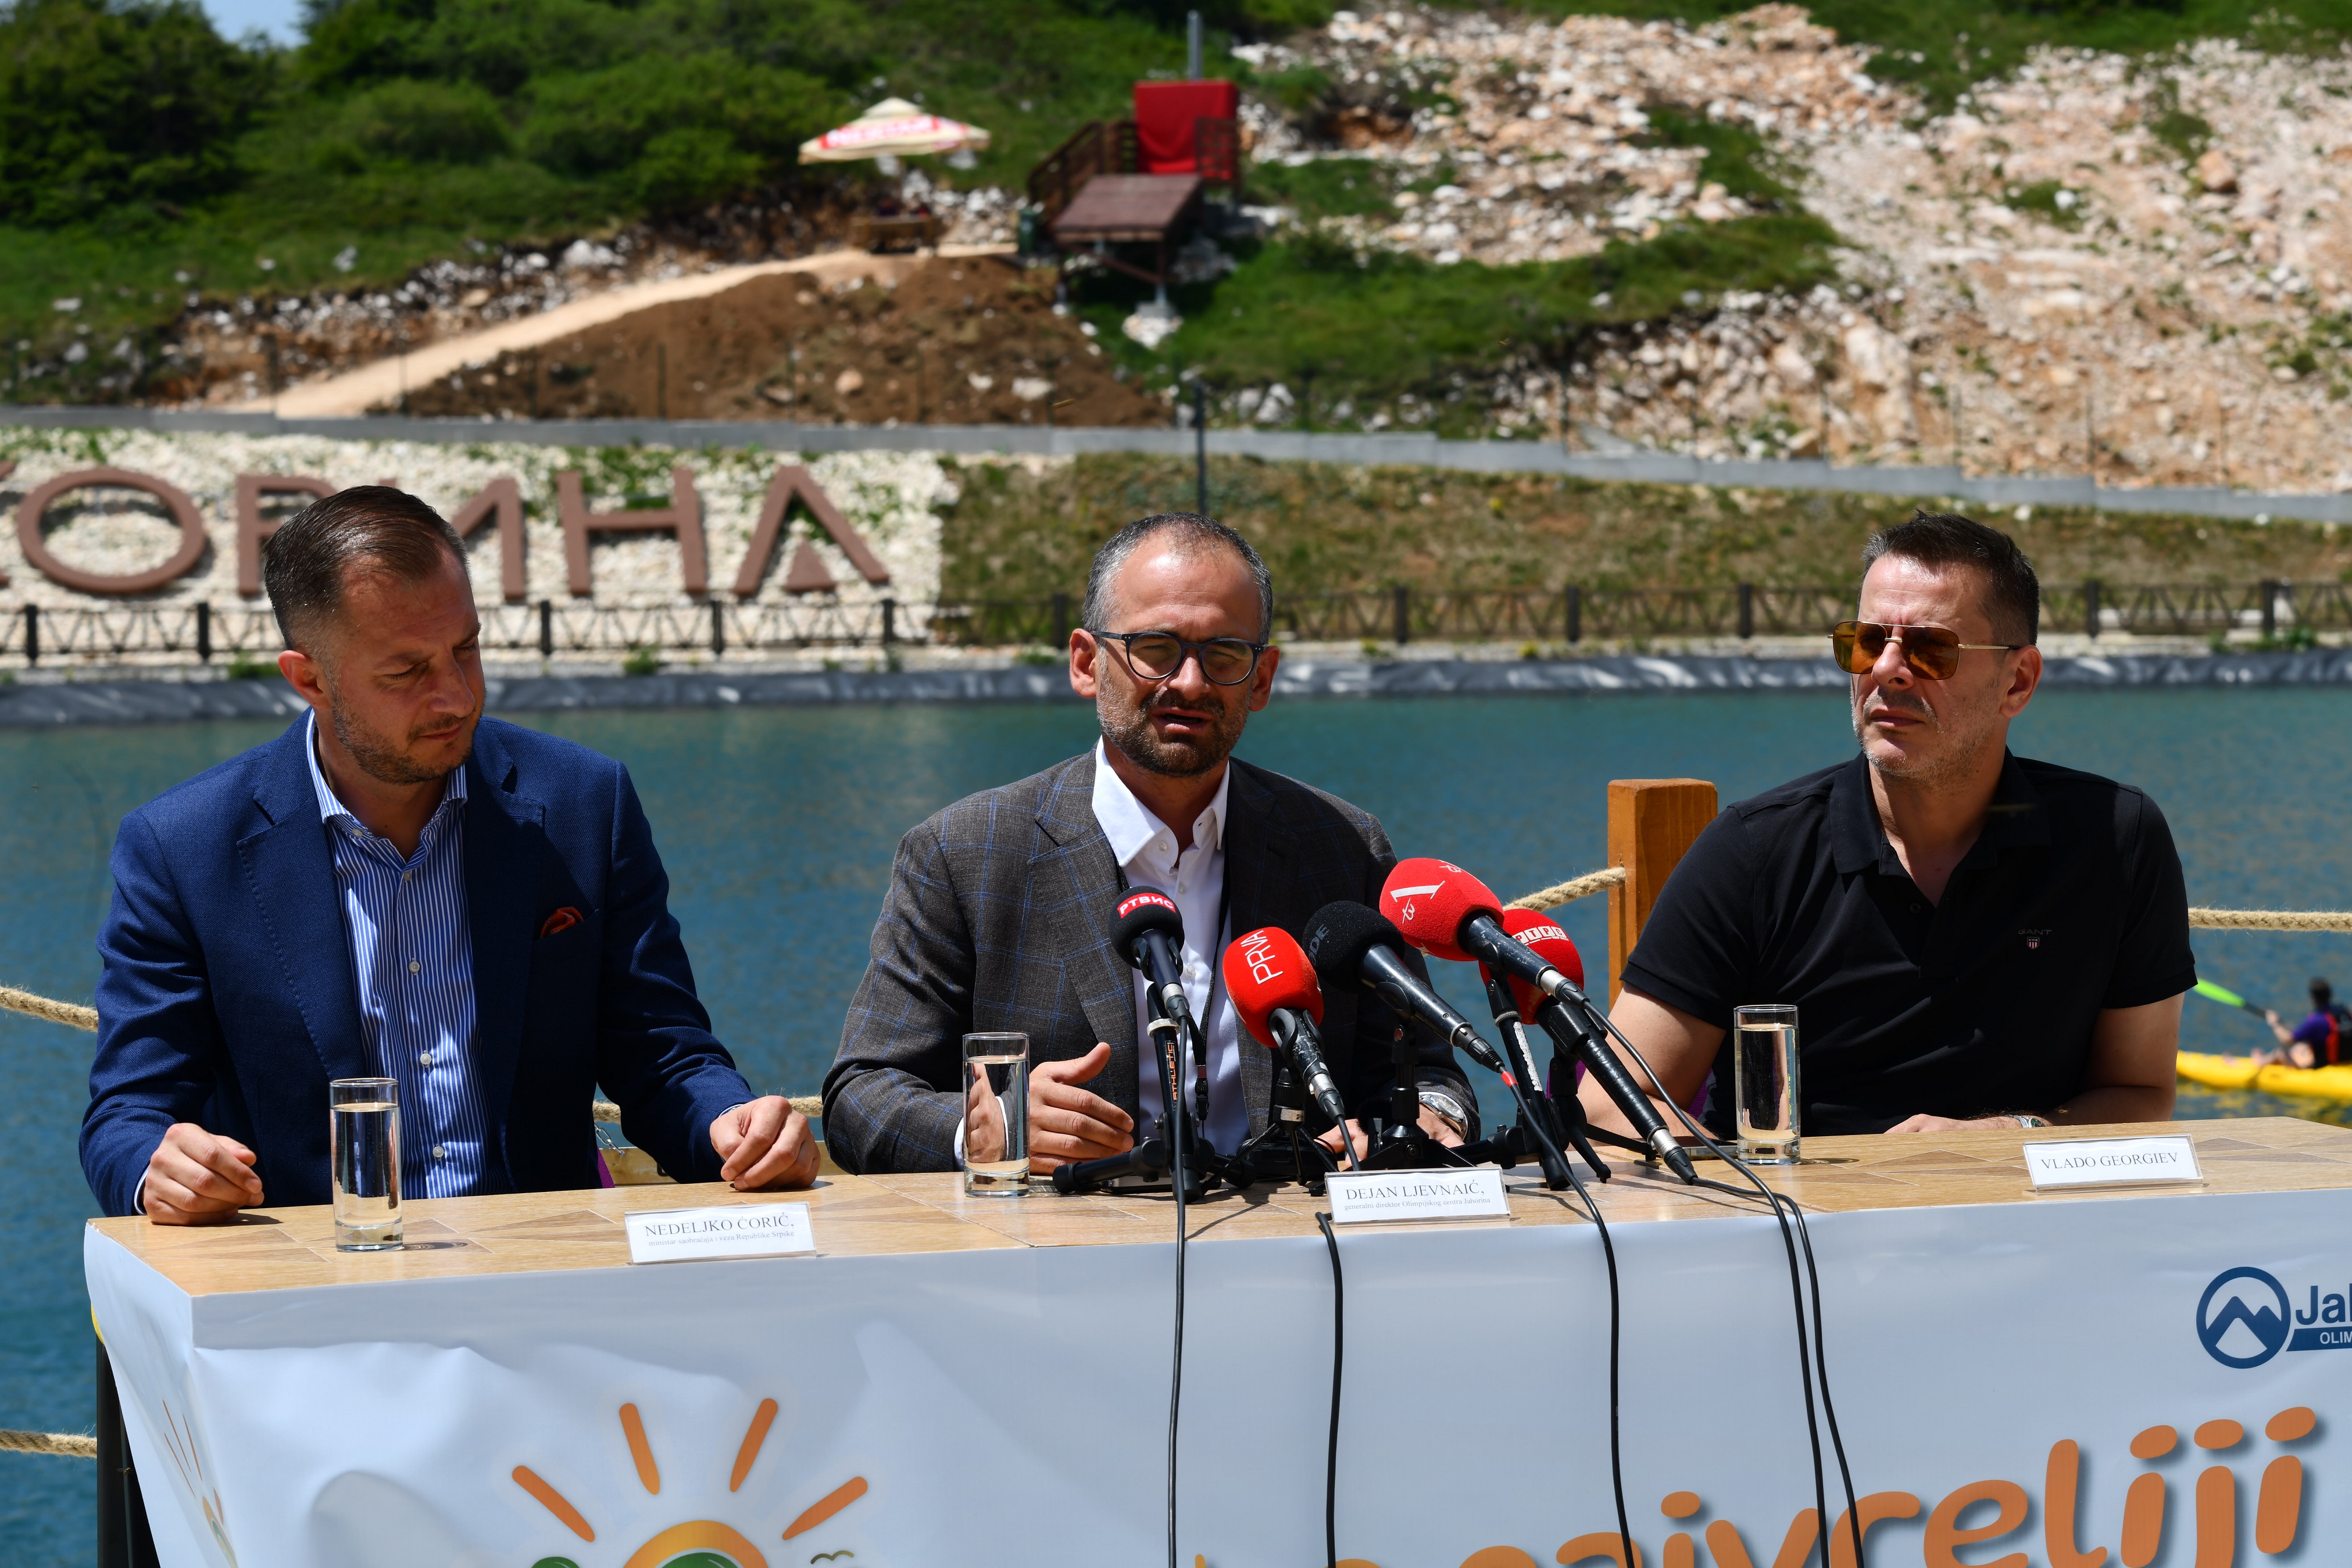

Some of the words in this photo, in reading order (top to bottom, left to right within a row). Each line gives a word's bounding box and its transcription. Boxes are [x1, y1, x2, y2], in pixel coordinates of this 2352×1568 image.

[0, 461, 890, 599] ОРИНА
[1120, 896, 1174, 914] РТВИС
[1241, 930, 1283, 985] PRVA
[1167, 1044, 1178, 1100] ATHLETIC
[2040, 1156, 2096, 1170] VLADO
[2100, 1152, 2178, 1167] GEORGIEV
[1346, 1186, 1397, 1200] DEJAN
[1402, 1179, 1484, 1197] LJEVNAIĆ,
[1344, 1202, 1374, 1211] generalni
[1402, 1200, 1442, 1208] Olimpijskog
[644, 1219, 732, 1236] NEDELJKO
[737, 1212, 794, 1230] ĆORIĆ,
[678, 1236, 713, 1244] saobraćaja
[736, 1232, 770, 1240] Republike
[771, 1230, 794, 1238] Srpske
[2296, 1283, 2352, 1325] Ja
